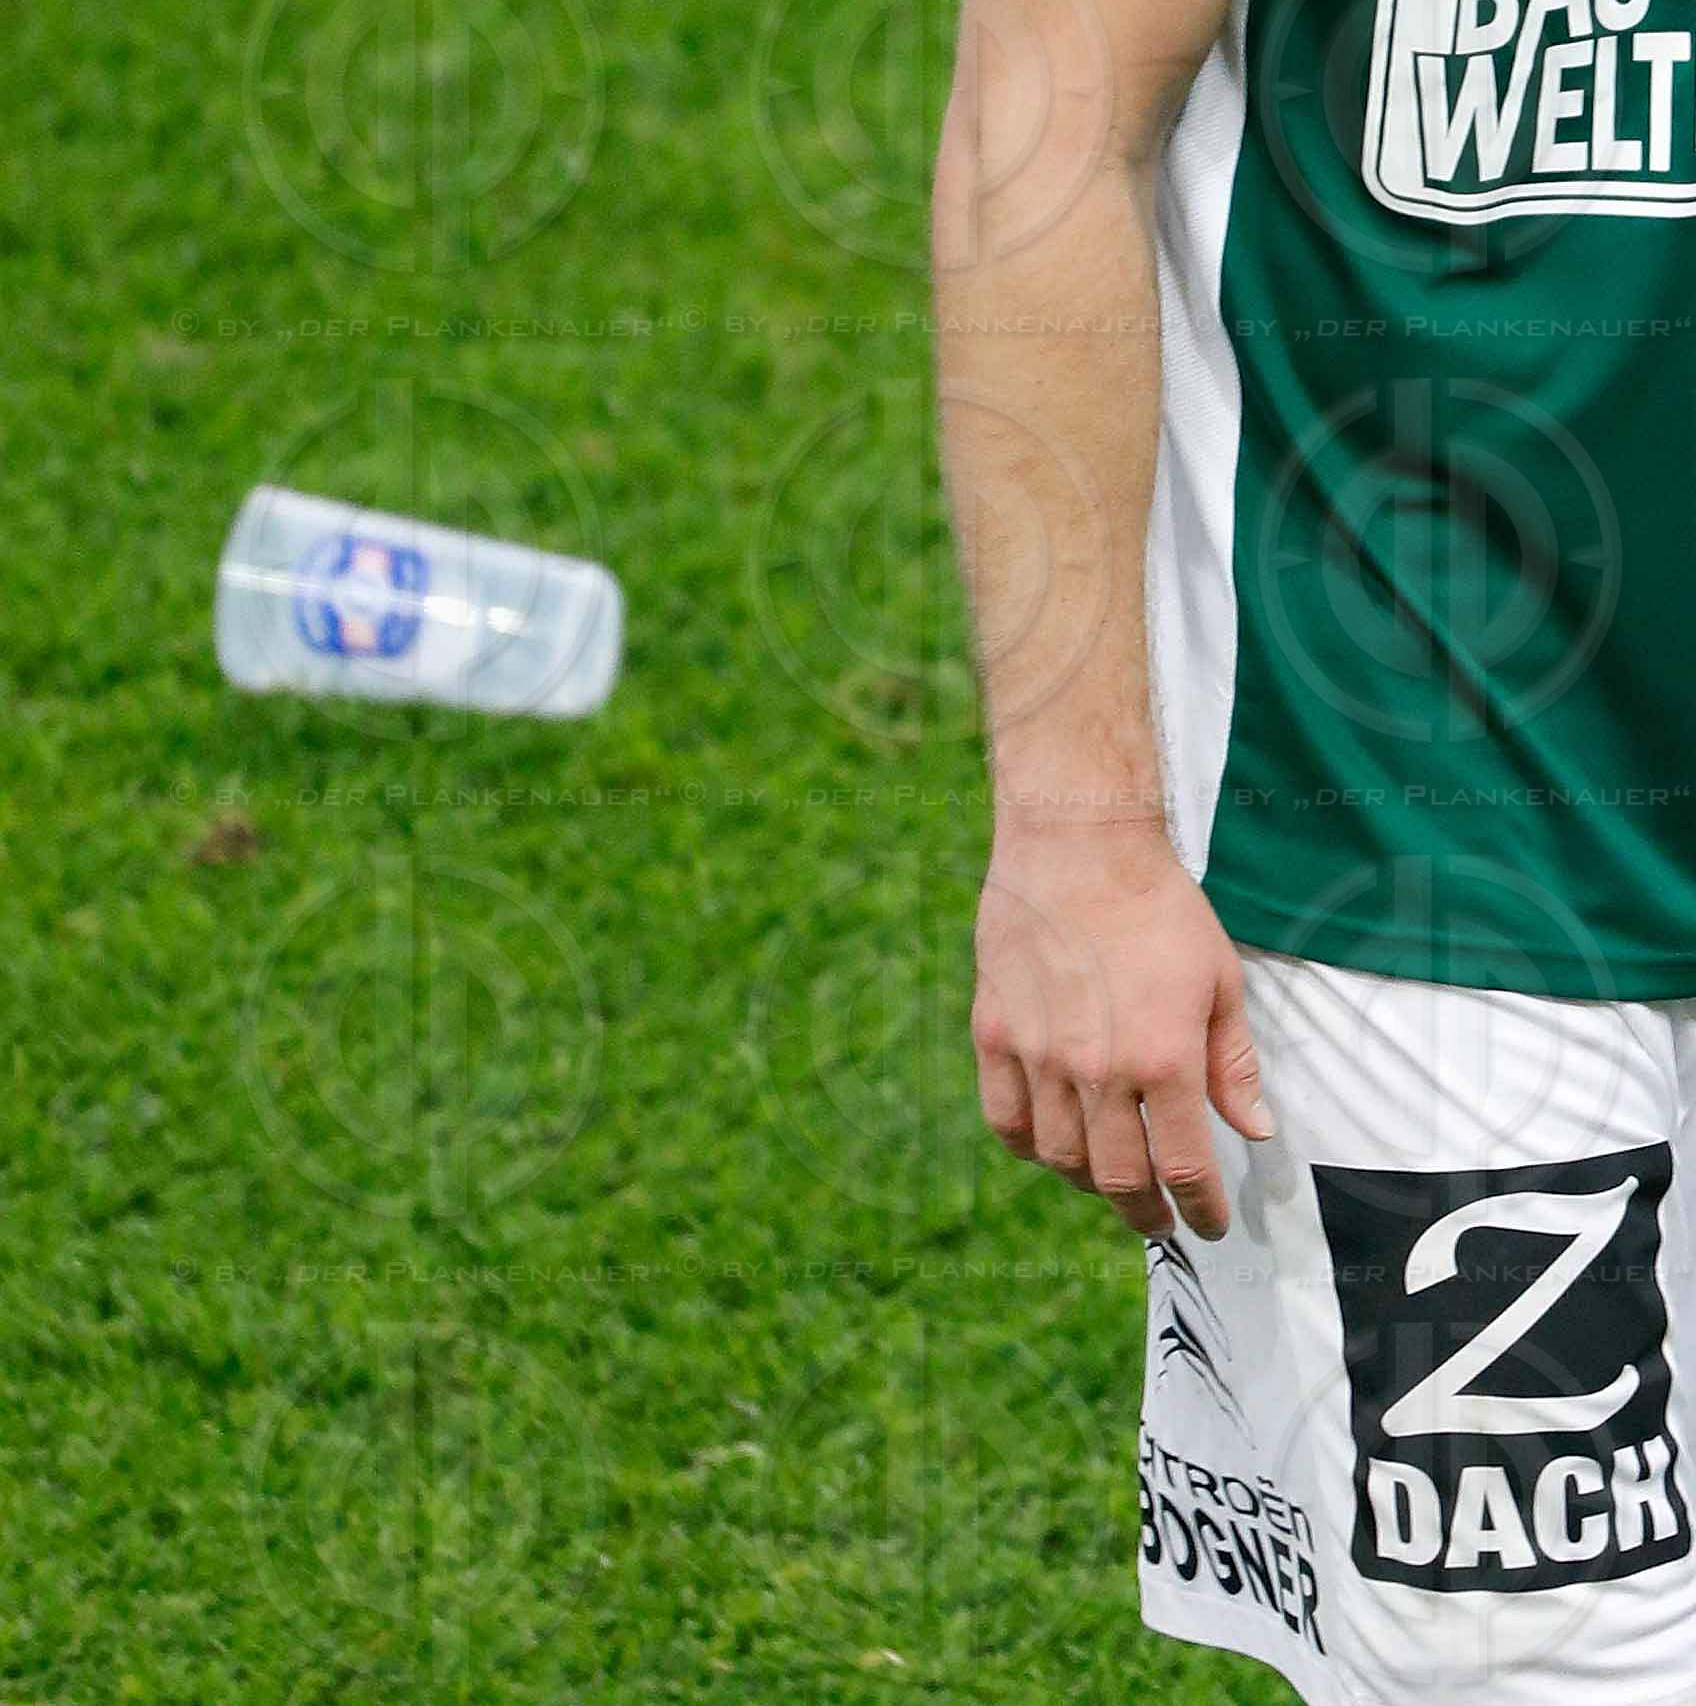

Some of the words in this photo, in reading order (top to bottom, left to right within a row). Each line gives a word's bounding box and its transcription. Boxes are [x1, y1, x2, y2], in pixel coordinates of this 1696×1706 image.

[1416, 31, 1692, 183] WELT
[1379, 1175, 1641, 1438] Z
[1366, 1436, 1679, 1570] DACH
